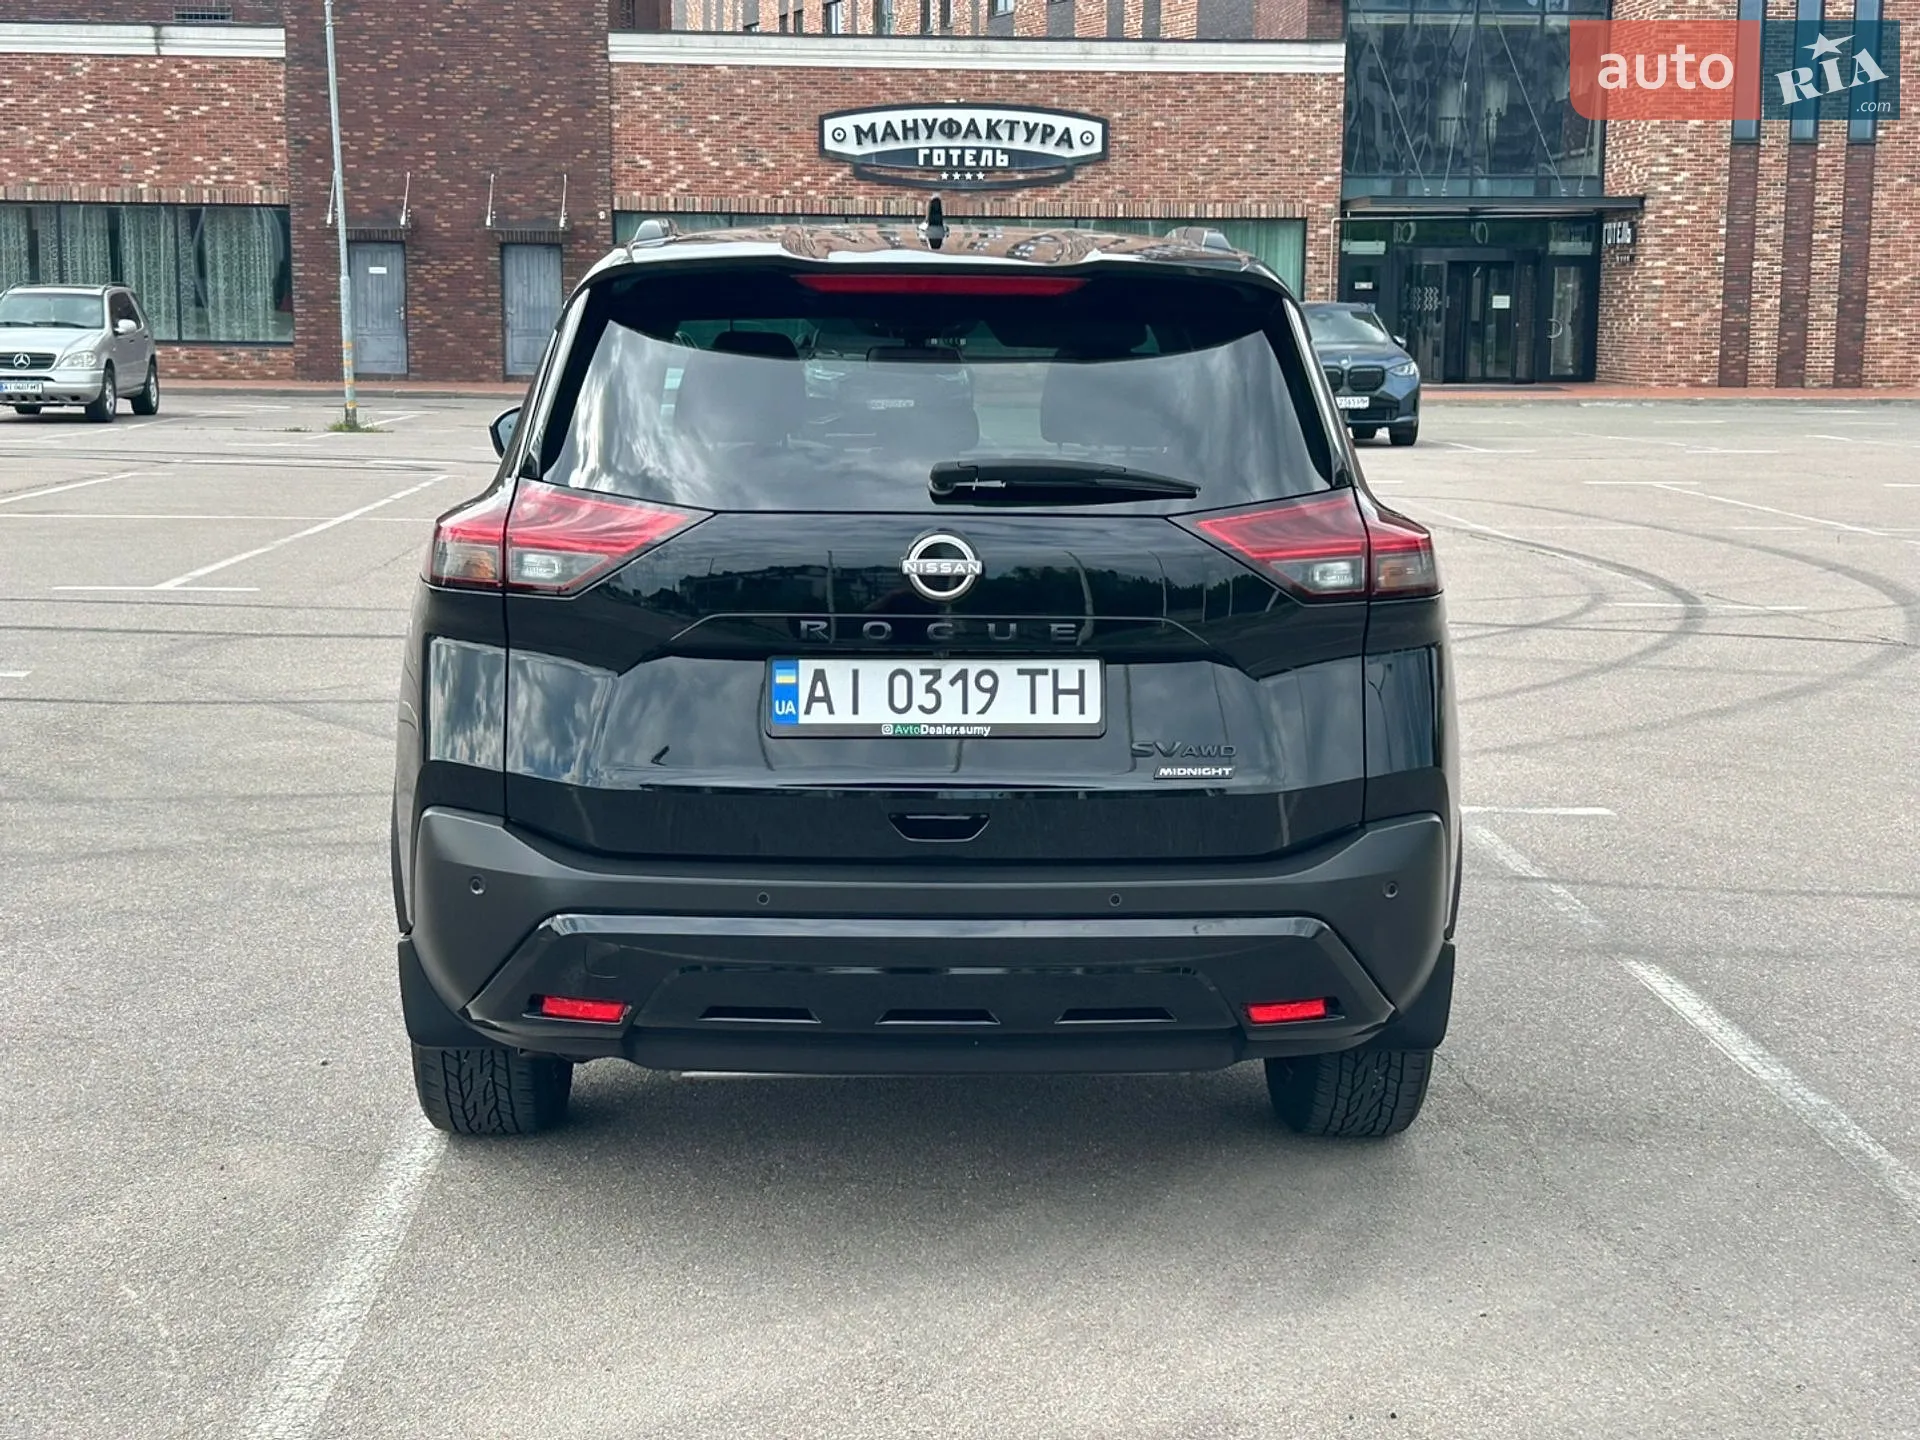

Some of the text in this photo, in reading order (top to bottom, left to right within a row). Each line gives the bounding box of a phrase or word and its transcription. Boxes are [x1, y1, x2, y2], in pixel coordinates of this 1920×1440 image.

[853, 117, 1074, 149] МАНУФАКТУРА
[918, 149, 1009, 166] ГОТЕЛЬ
[904, 562, 980, 573] NISSAN
[803, 669, 1086, 715] AI 0319 TH
[775, 700, 795, 715] UA
[1131, 741, 1236, 758] SV AWD
[1159, 767, 1232, 776] MIDNIGHT
